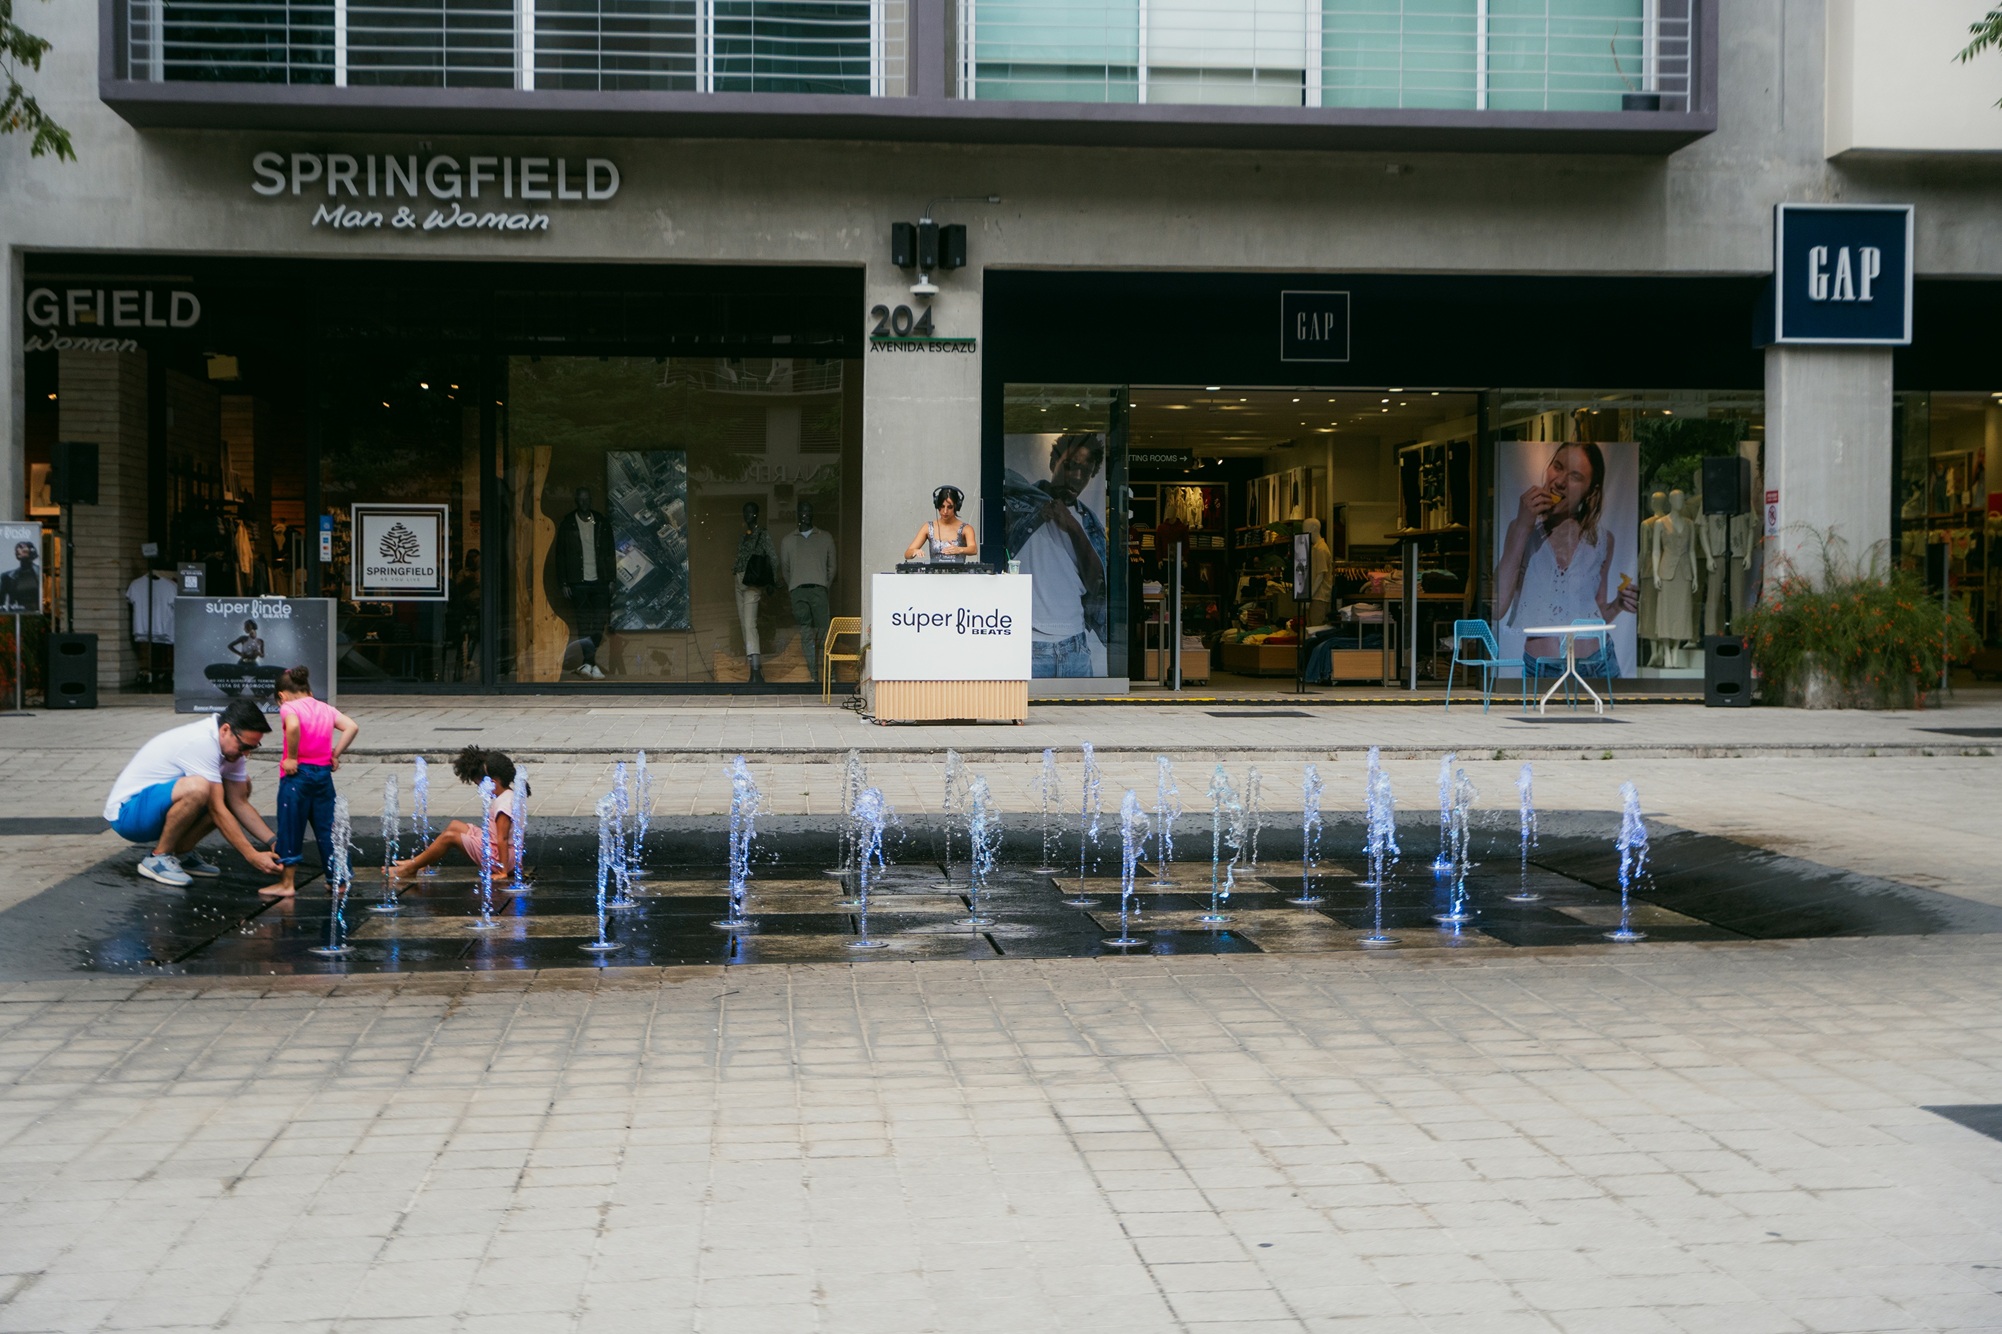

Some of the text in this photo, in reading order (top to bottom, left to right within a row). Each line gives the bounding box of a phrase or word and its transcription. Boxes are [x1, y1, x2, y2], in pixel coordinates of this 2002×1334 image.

[251, 151, 621, 201] SPRINGFIELD
[311, 203, 550, 231] Man & Woman
[1808, 244, 1882, 303] GAP
[26, 287, 201, 328] GFIELD
[870, 304, 936, 337] 204
[1296, 311, 1335, 342] GAP
[870, 342, 925, 353] AVENIDA
[1149, 454, 1178, 462] ROOMS
[366, 566, 434, 576] SPRINGFIELD
[205, 599, 292, 619] súper finde
[891, 606, 1013, 635] súper finde
[971, 628, 1012, 636] BEATS
